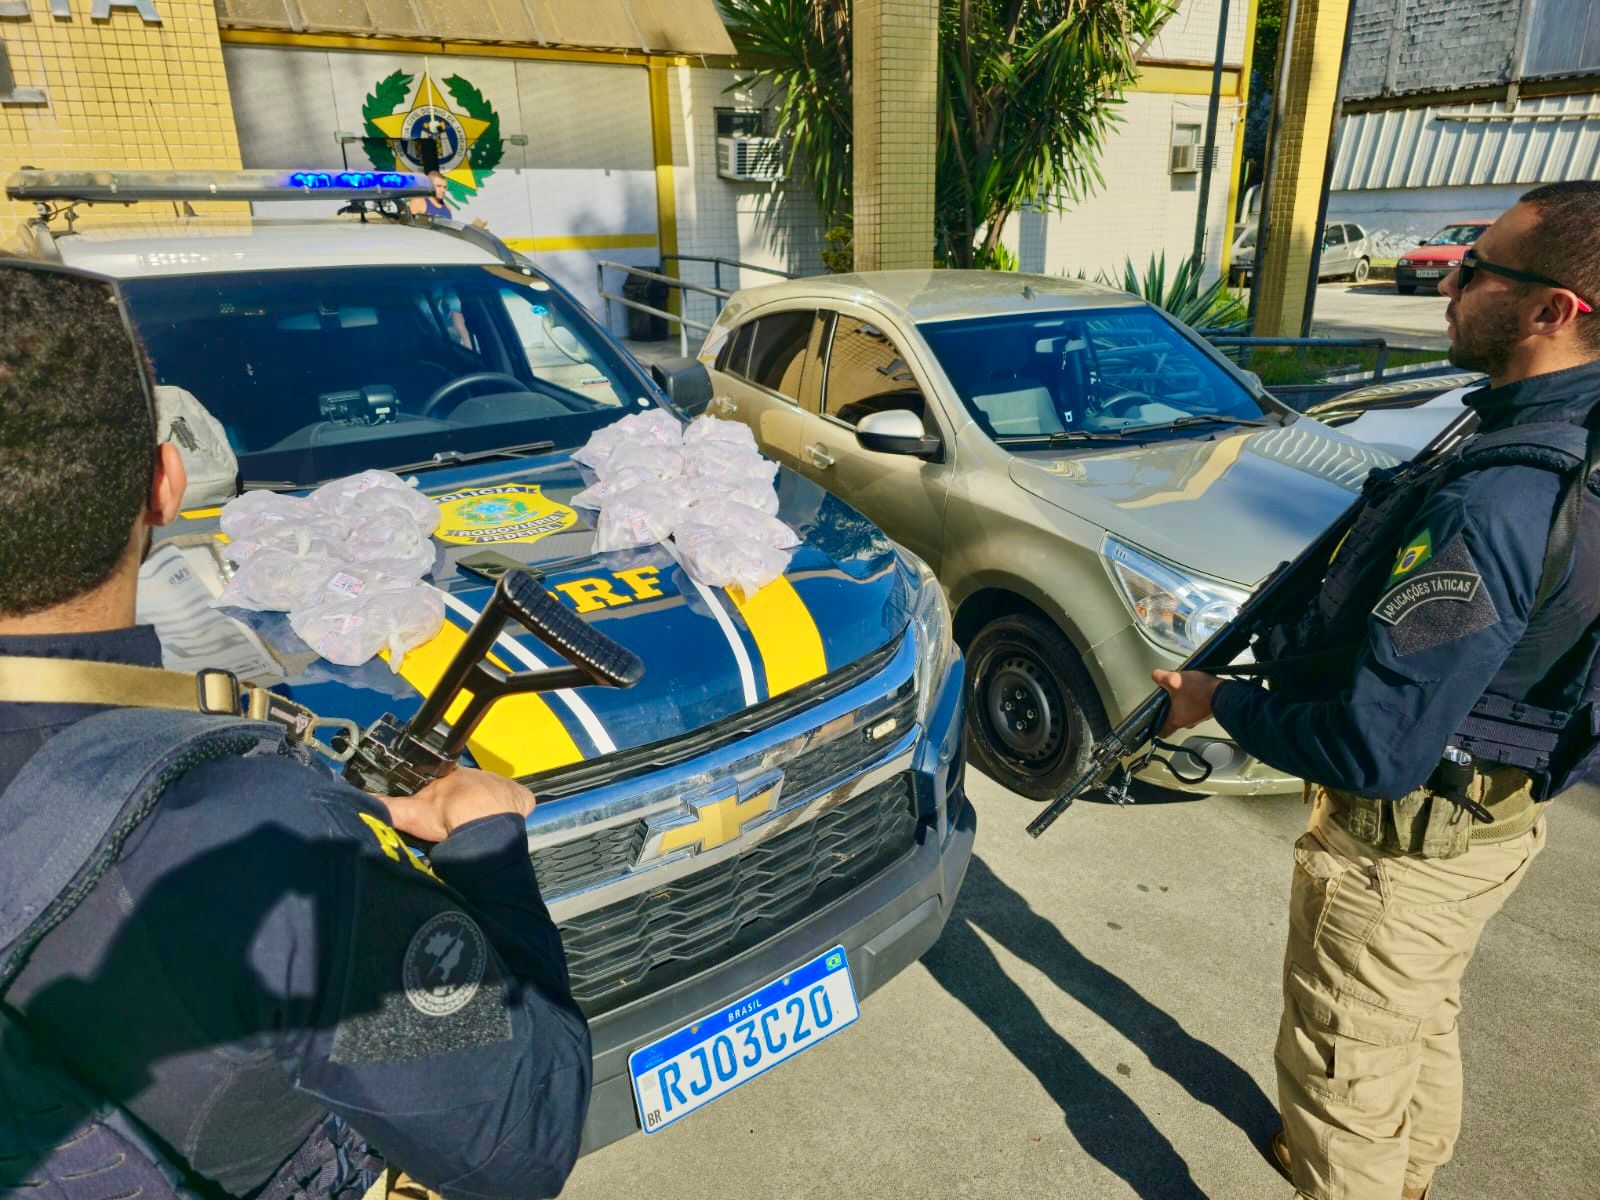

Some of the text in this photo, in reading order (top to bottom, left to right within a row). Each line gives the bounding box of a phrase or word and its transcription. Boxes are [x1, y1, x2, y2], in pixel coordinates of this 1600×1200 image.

[482, 524, 562, 542] FEDERAL
[546, 565, 664, 613] RF
[1383, 577, 1471, 618] APLICAÇÕES TÁTICAS
[728, 999, 762, 1022] BRASIL
[647, 1109, 662, 1127] BR
